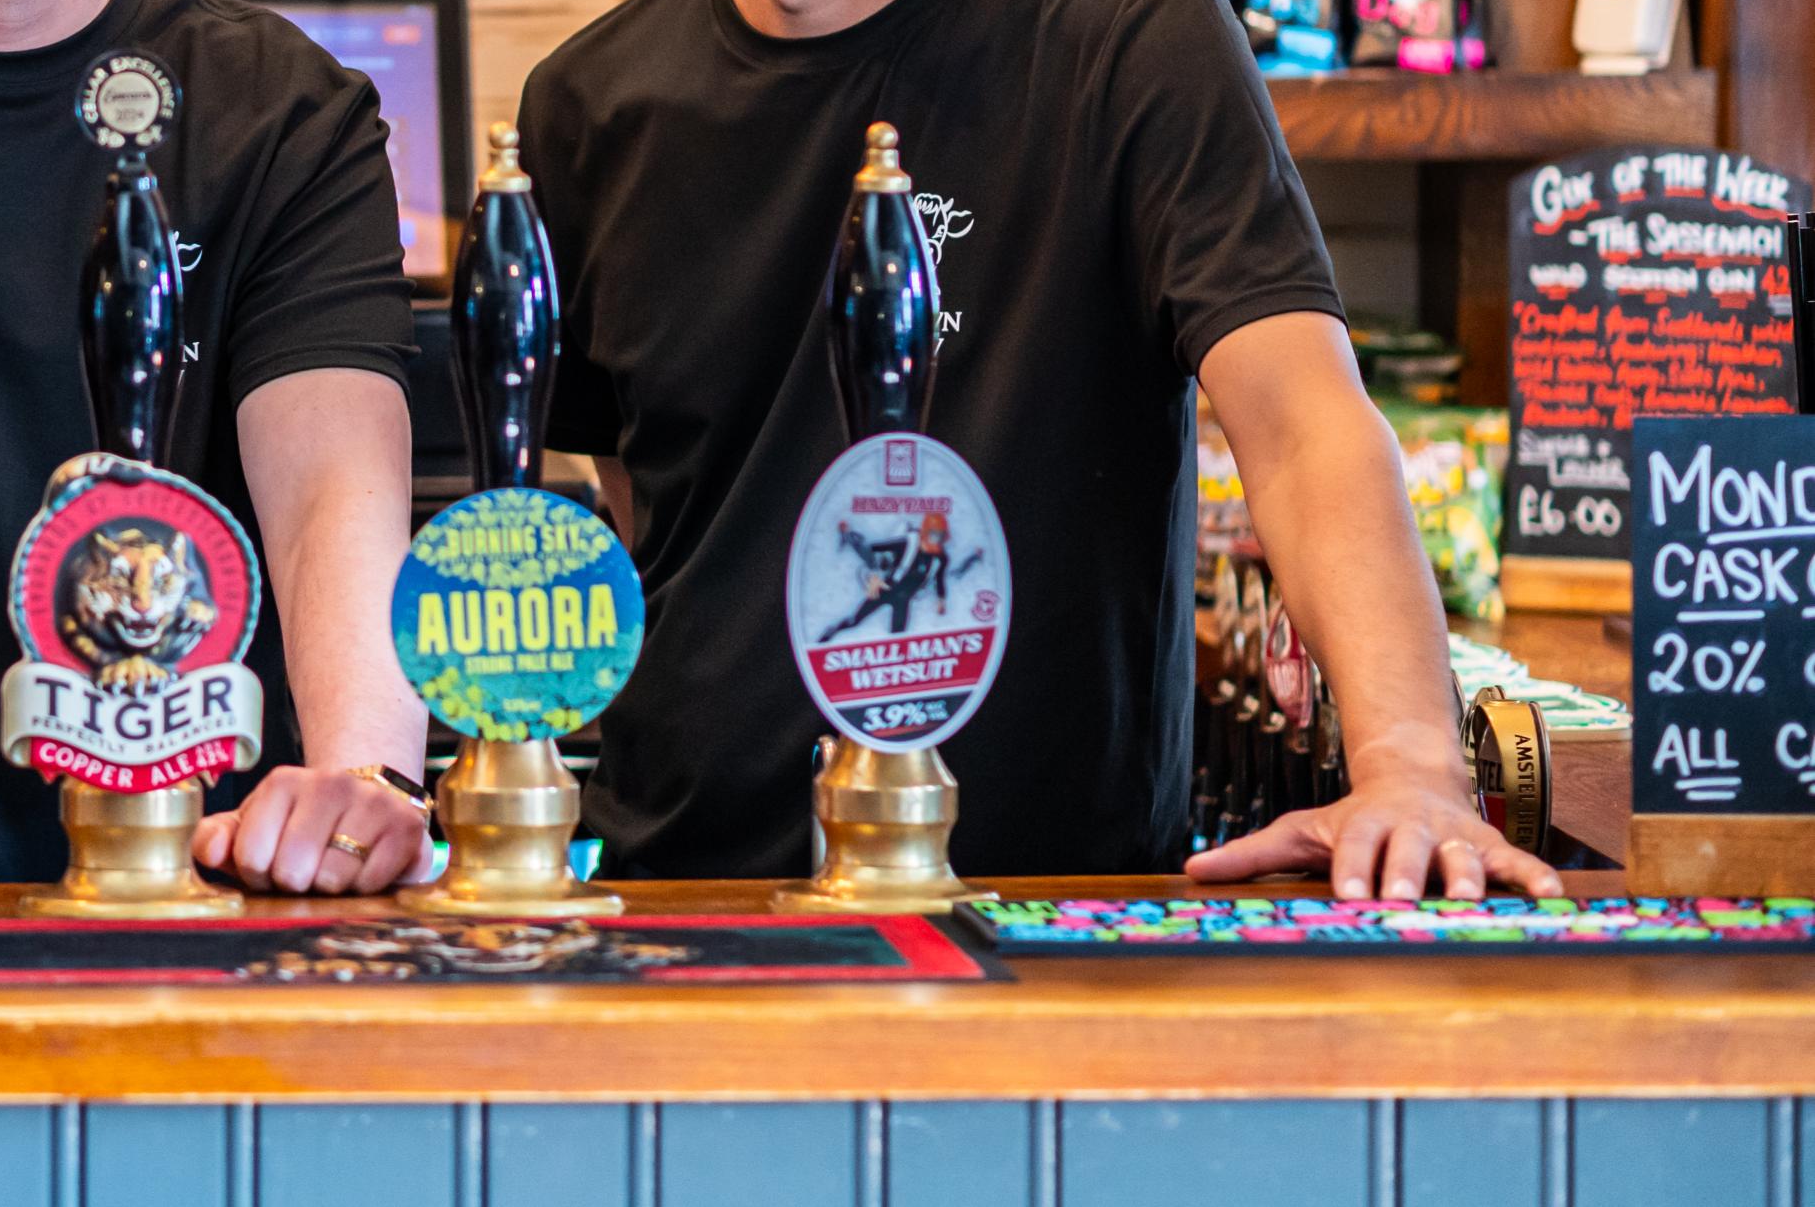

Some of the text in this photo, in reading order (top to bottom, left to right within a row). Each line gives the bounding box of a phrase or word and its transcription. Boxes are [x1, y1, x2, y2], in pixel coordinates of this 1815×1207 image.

[1653, 543, 1799, 604] CASK
[417, 583, 618, 656] AURORA
[823, 633, 984, 672] SMALL MAN'S
[850, 658, 959, 690] WETSUIT
[1648, 632, 1766, 693] 20%
[34, 676, 233, 741] TIGER
[38, 742, 195, 788] COPPER ALE
[1515, 734, 1536, 804] AMSTEL
[1652, 723, 1739, 777] ALL
